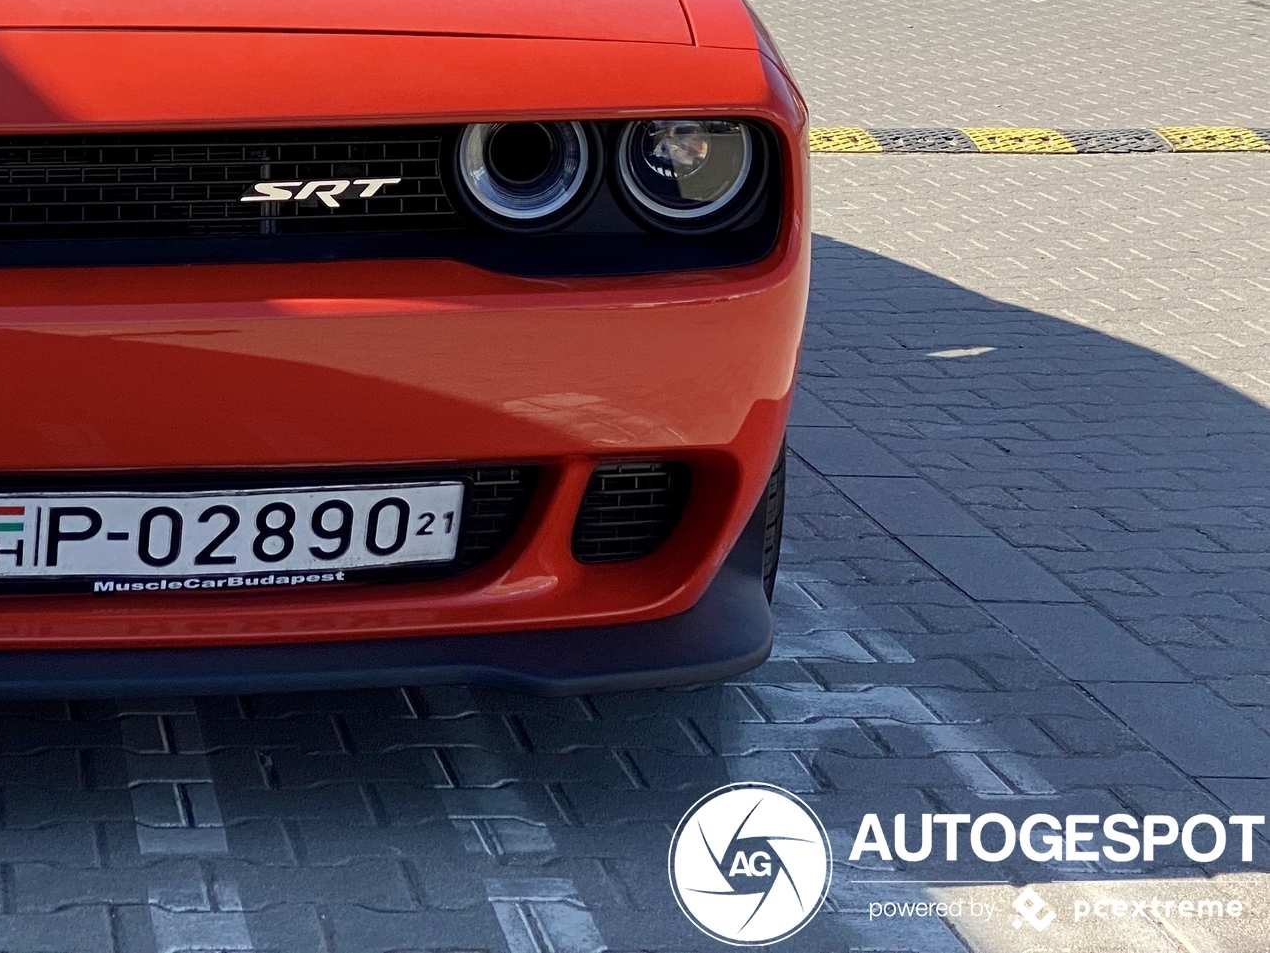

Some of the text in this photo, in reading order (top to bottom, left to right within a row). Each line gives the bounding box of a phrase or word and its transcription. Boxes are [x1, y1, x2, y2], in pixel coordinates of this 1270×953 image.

[240, 177, 402, 208] SRT
[45, 496, 411, 568] P-02890
[415, 510, 455, 536] 21
[93, 570, 346, 593] MuscleCarBudapest
